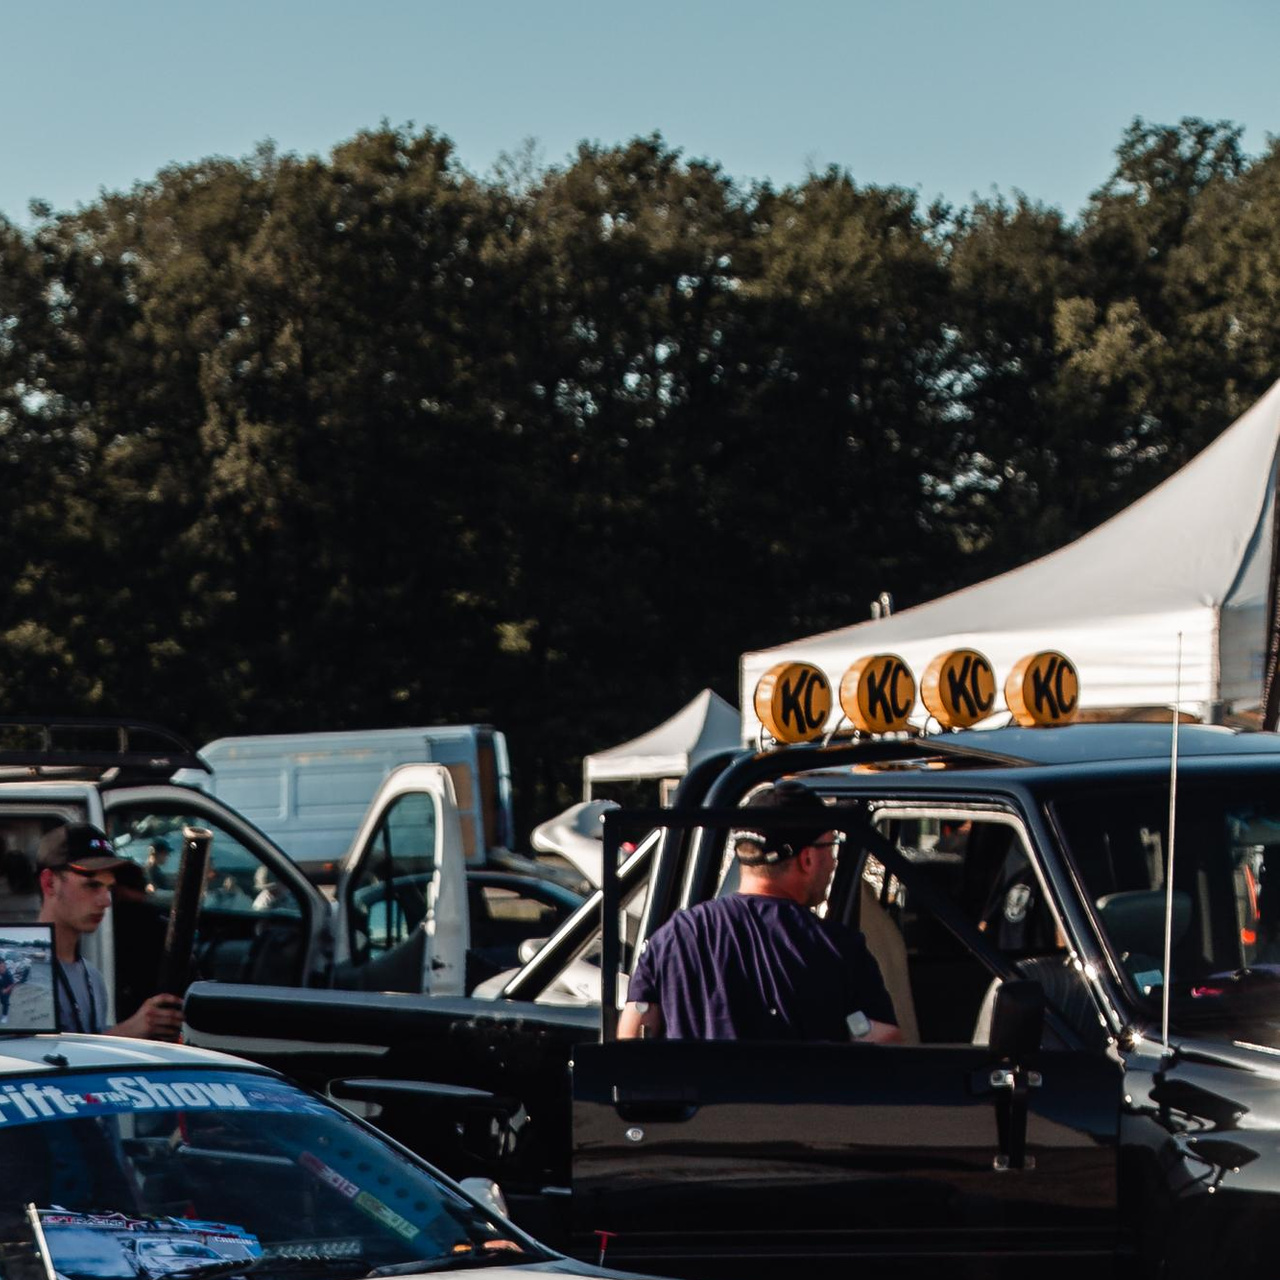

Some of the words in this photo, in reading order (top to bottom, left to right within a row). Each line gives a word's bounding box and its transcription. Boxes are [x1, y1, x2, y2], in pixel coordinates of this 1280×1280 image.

[781, 669, 827, 734] KC
[867, 659, 913, 725] KC
[948, 655, 993, 719] KC
[1032, 656, 1077, 719] KC
[106, 1075, 252, 1110] Show
